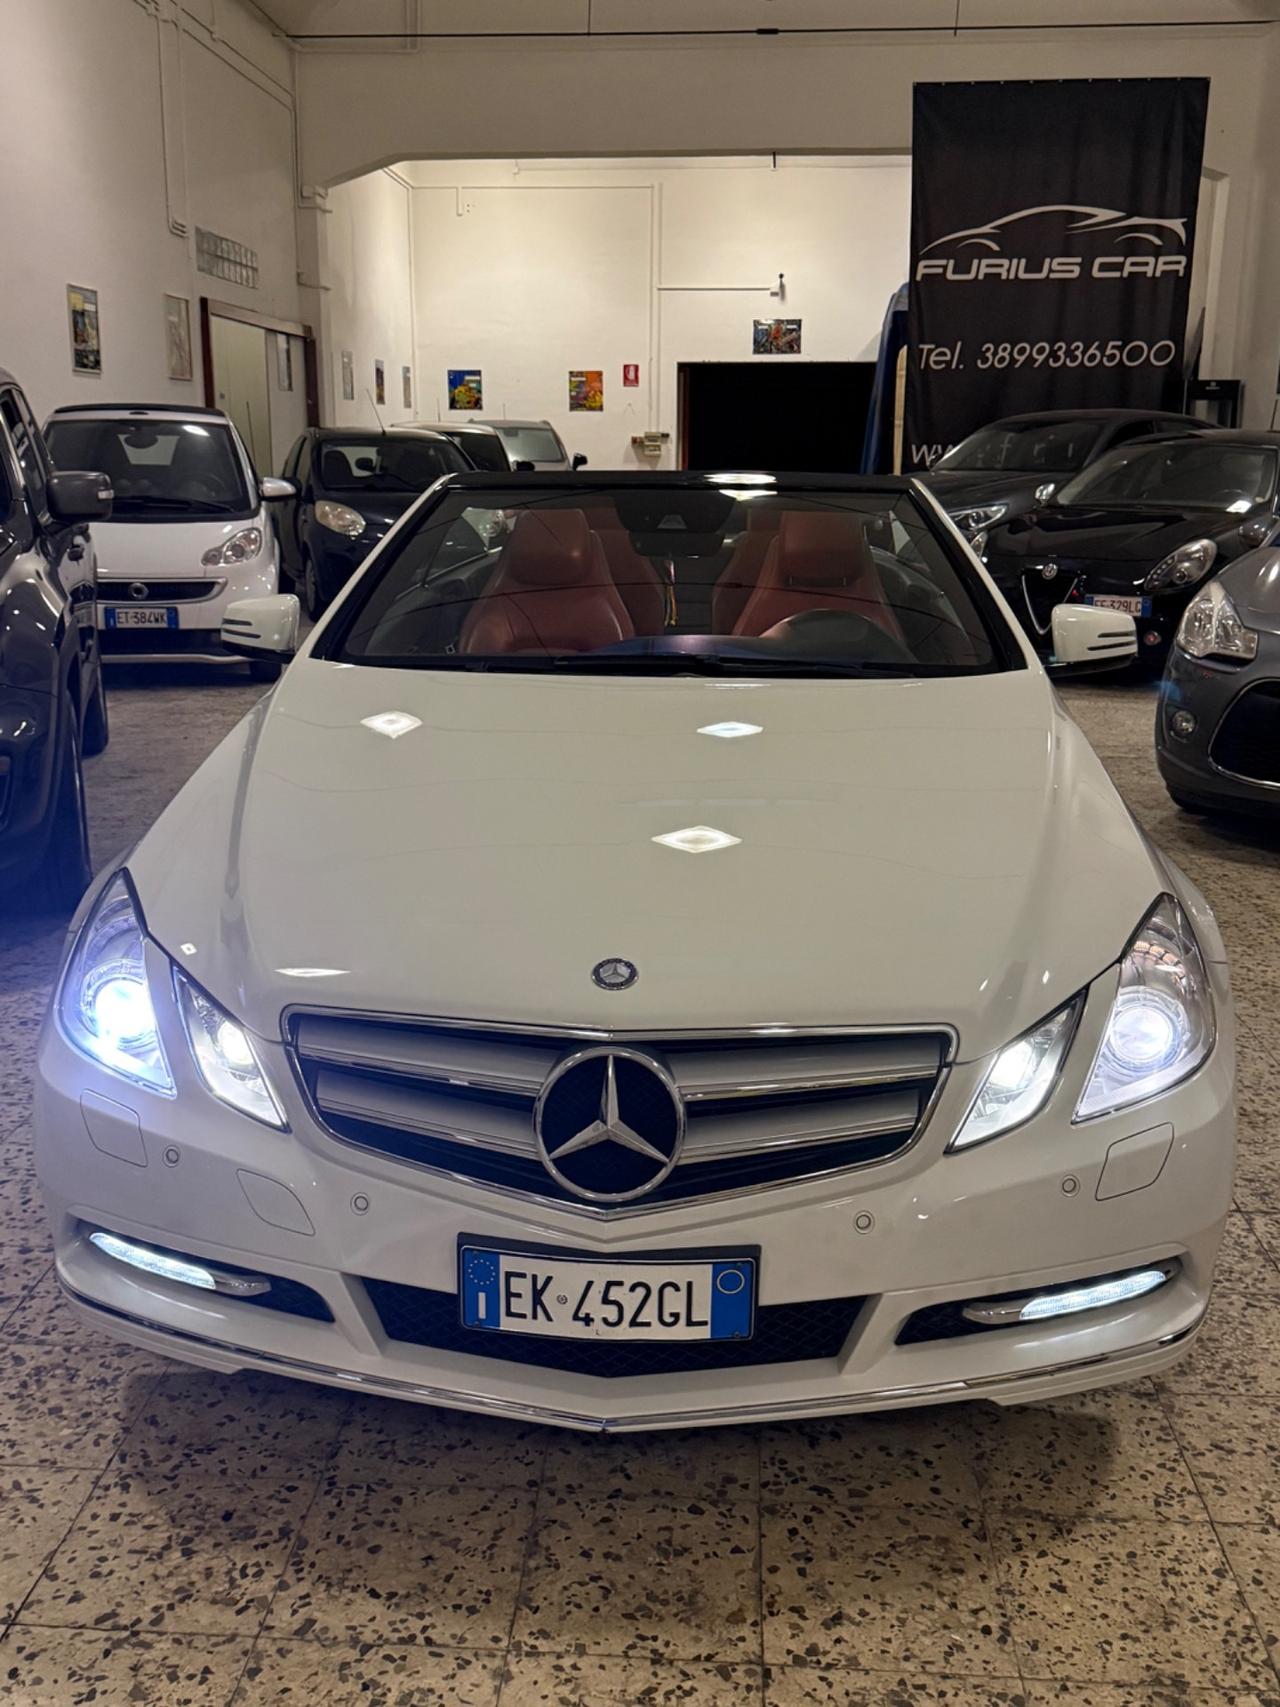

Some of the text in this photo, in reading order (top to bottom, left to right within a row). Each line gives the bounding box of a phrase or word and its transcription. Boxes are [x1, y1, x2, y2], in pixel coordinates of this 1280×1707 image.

[916, 255, 1187, 281] FURIUS CAR
[918, 340, 1176, 370] Tel. 3899336500
[504, 1270, 554, 1322] EK
[572, 1280, 709, 1328] 452GL
